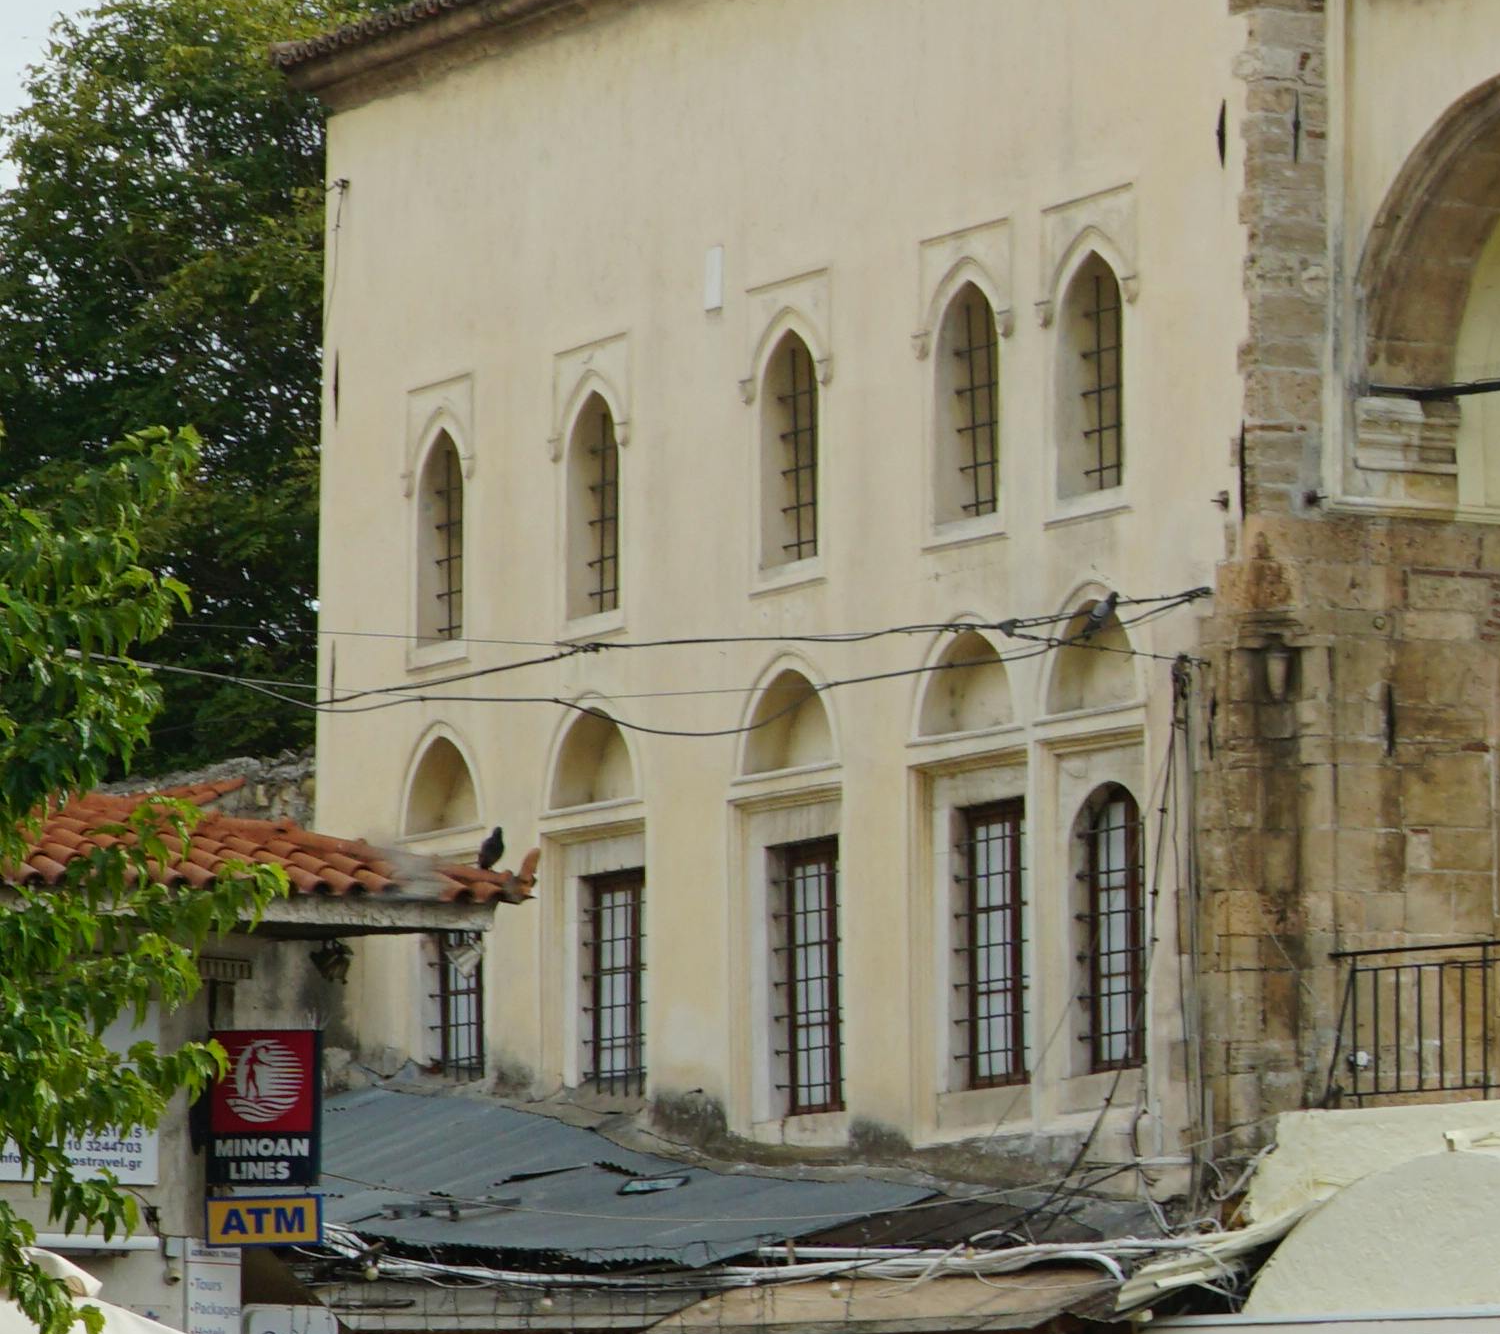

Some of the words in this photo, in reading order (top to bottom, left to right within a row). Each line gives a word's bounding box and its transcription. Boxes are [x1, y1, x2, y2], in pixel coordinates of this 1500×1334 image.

[215, 1138, 310, 1157] MINOAN
[229, 1161, 291, 1180] LINES
[220, 1207, 305, 1235] ATM
